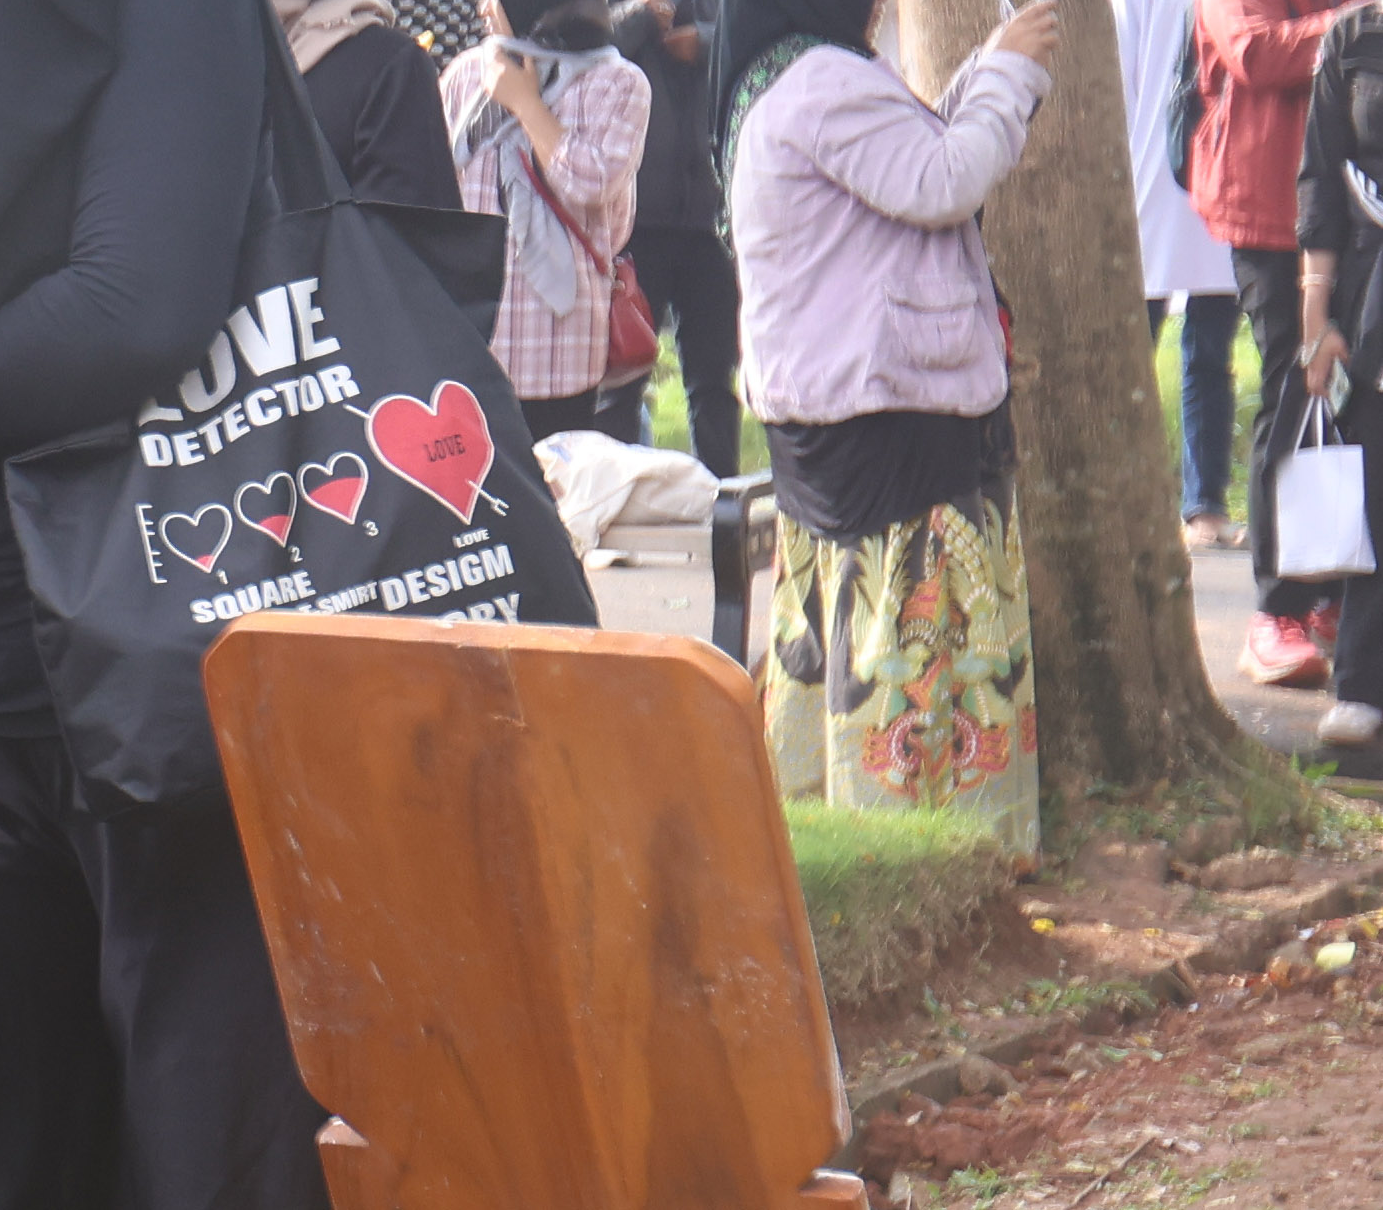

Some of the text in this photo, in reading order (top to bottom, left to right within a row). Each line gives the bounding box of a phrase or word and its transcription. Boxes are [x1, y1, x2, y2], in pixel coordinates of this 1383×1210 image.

[138, 364, 361, 467] DETECTOR
[424, 433, 466, 463] LOVE
[362, 520, 379, 537] 3
[453, 529, 490, 549] LOVE
[289, 545, 303, 563] 2
[190, 569, 316, 624] SQUARE
[379, 544, 516, 611] DESIGM
